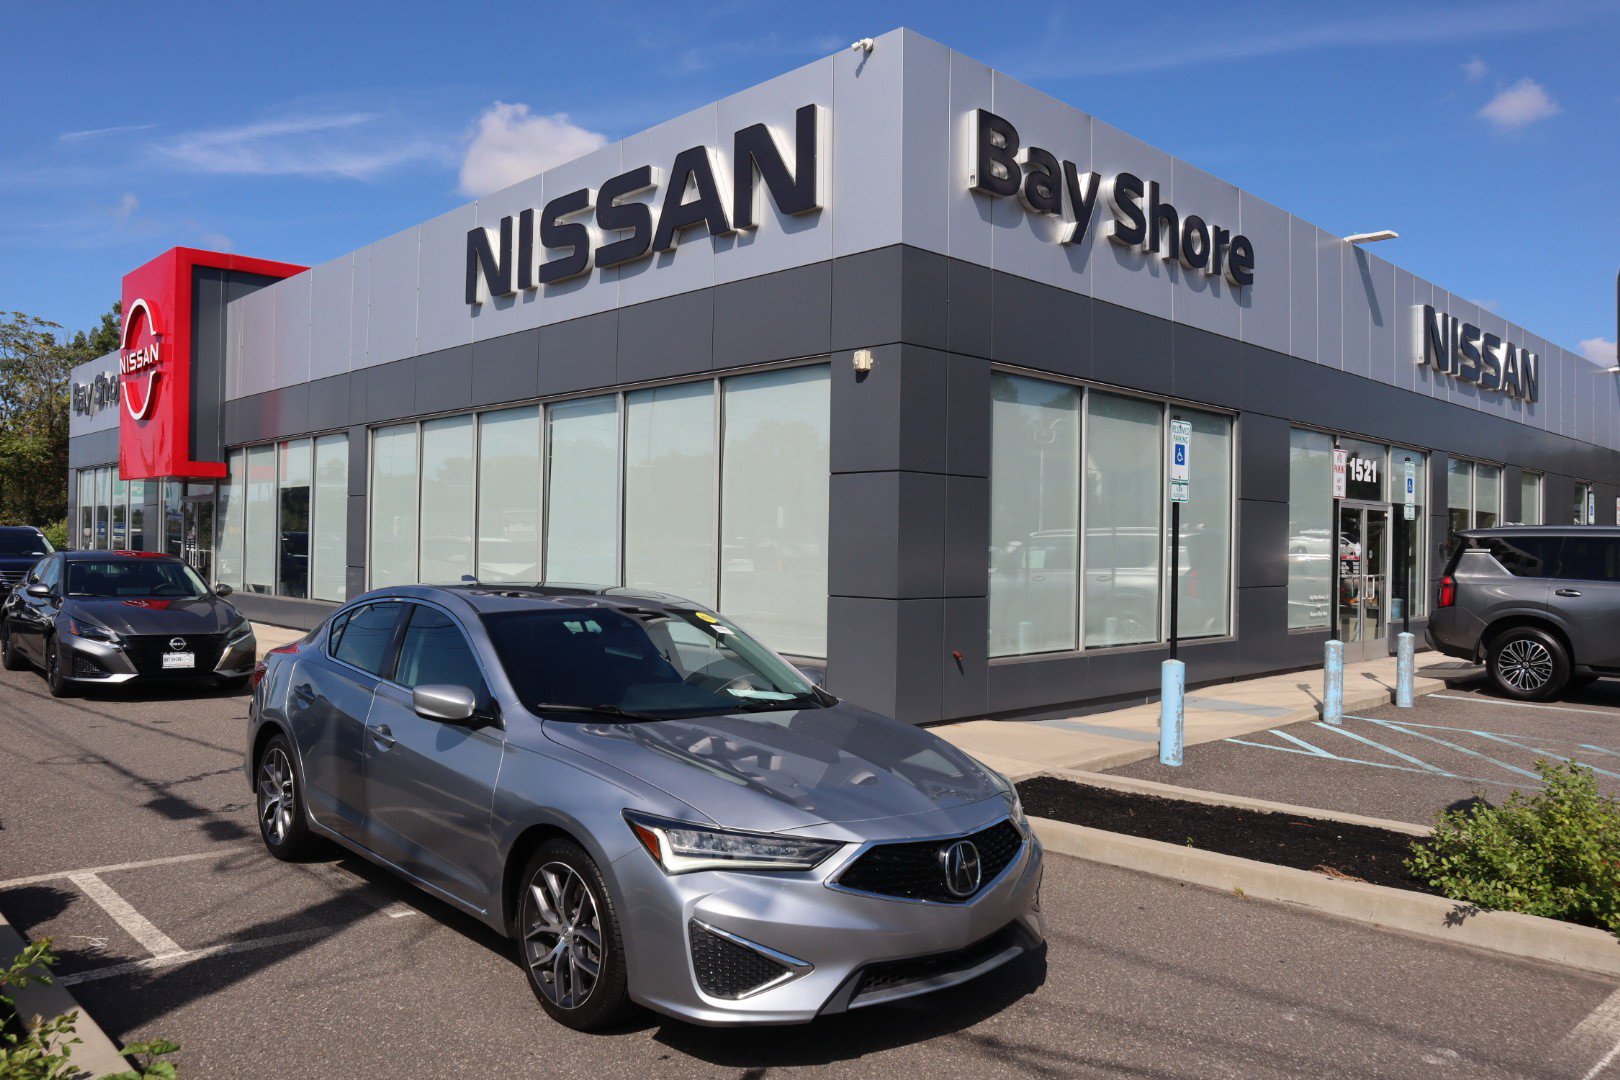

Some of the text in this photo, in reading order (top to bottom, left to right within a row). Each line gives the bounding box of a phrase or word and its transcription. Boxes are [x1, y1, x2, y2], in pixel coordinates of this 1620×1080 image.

[466, 103, 826, 306] NISSAN
[970, 108, 1256, 288] Bay Shore
[119, 342, 160, 375] NISSAN
[1417, 304, 1539, 403] NISSAN
[72, 382, 94, 416] Bay
[1349, 457, 1378, 484] 1521
